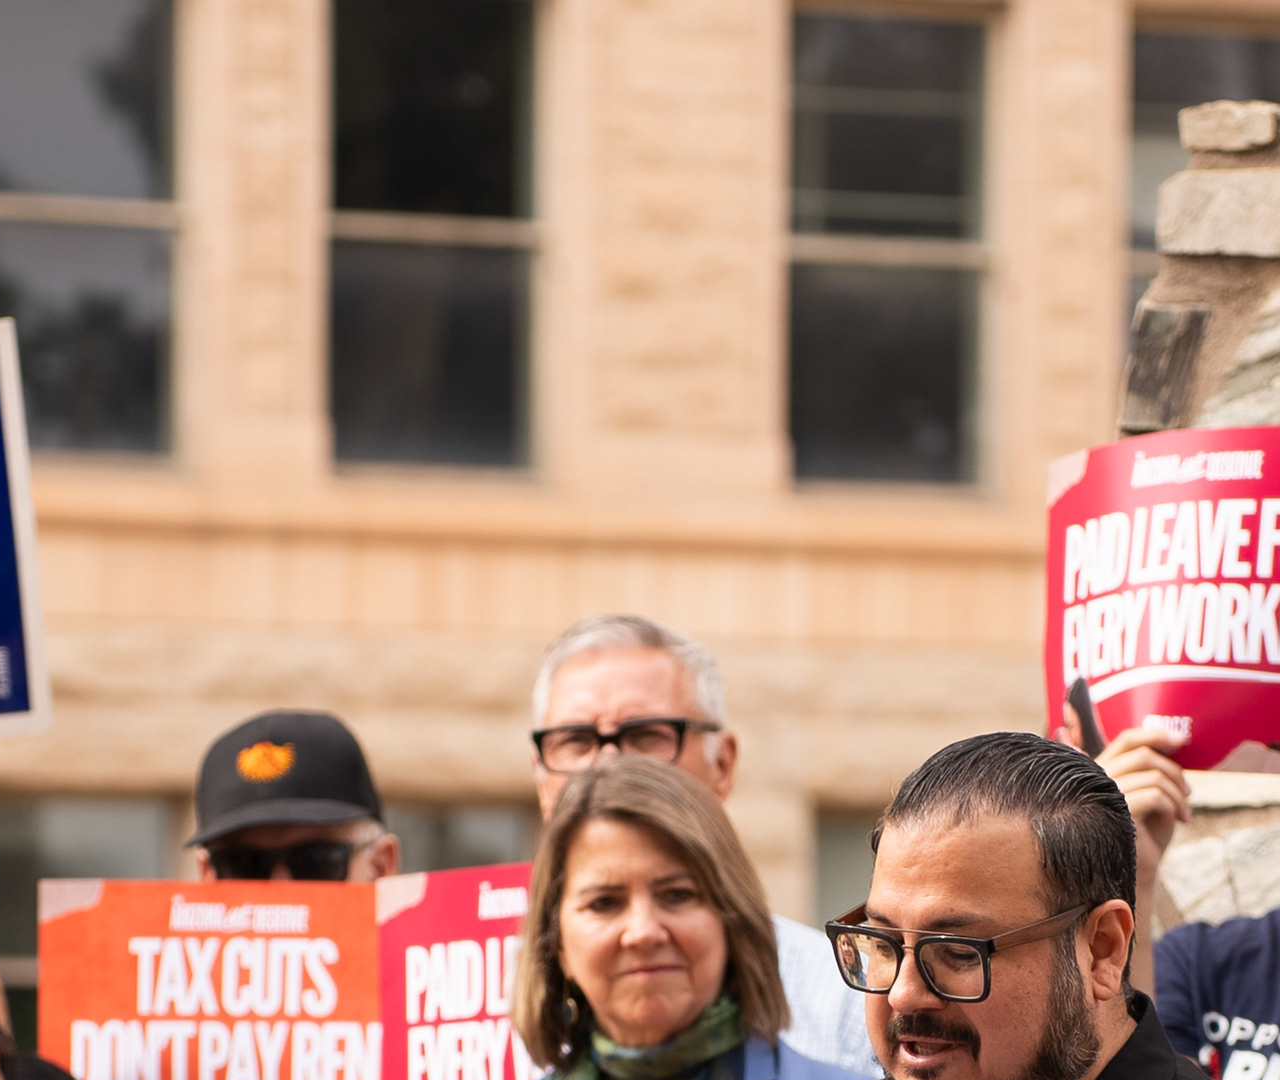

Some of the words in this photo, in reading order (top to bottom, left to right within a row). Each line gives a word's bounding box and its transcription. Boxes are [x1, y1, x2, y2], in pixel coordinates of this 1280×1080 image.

[1063, 511, 1130, 604] PAID
[1128, 499, 1257, 586] LEAVE
[1062, 588, 1149, 688] EVERY
[128, 936, 221, 1017] TAX
[221, 936, 340, 1018] CUTS
[405, 939, 484, 1024] PAID
